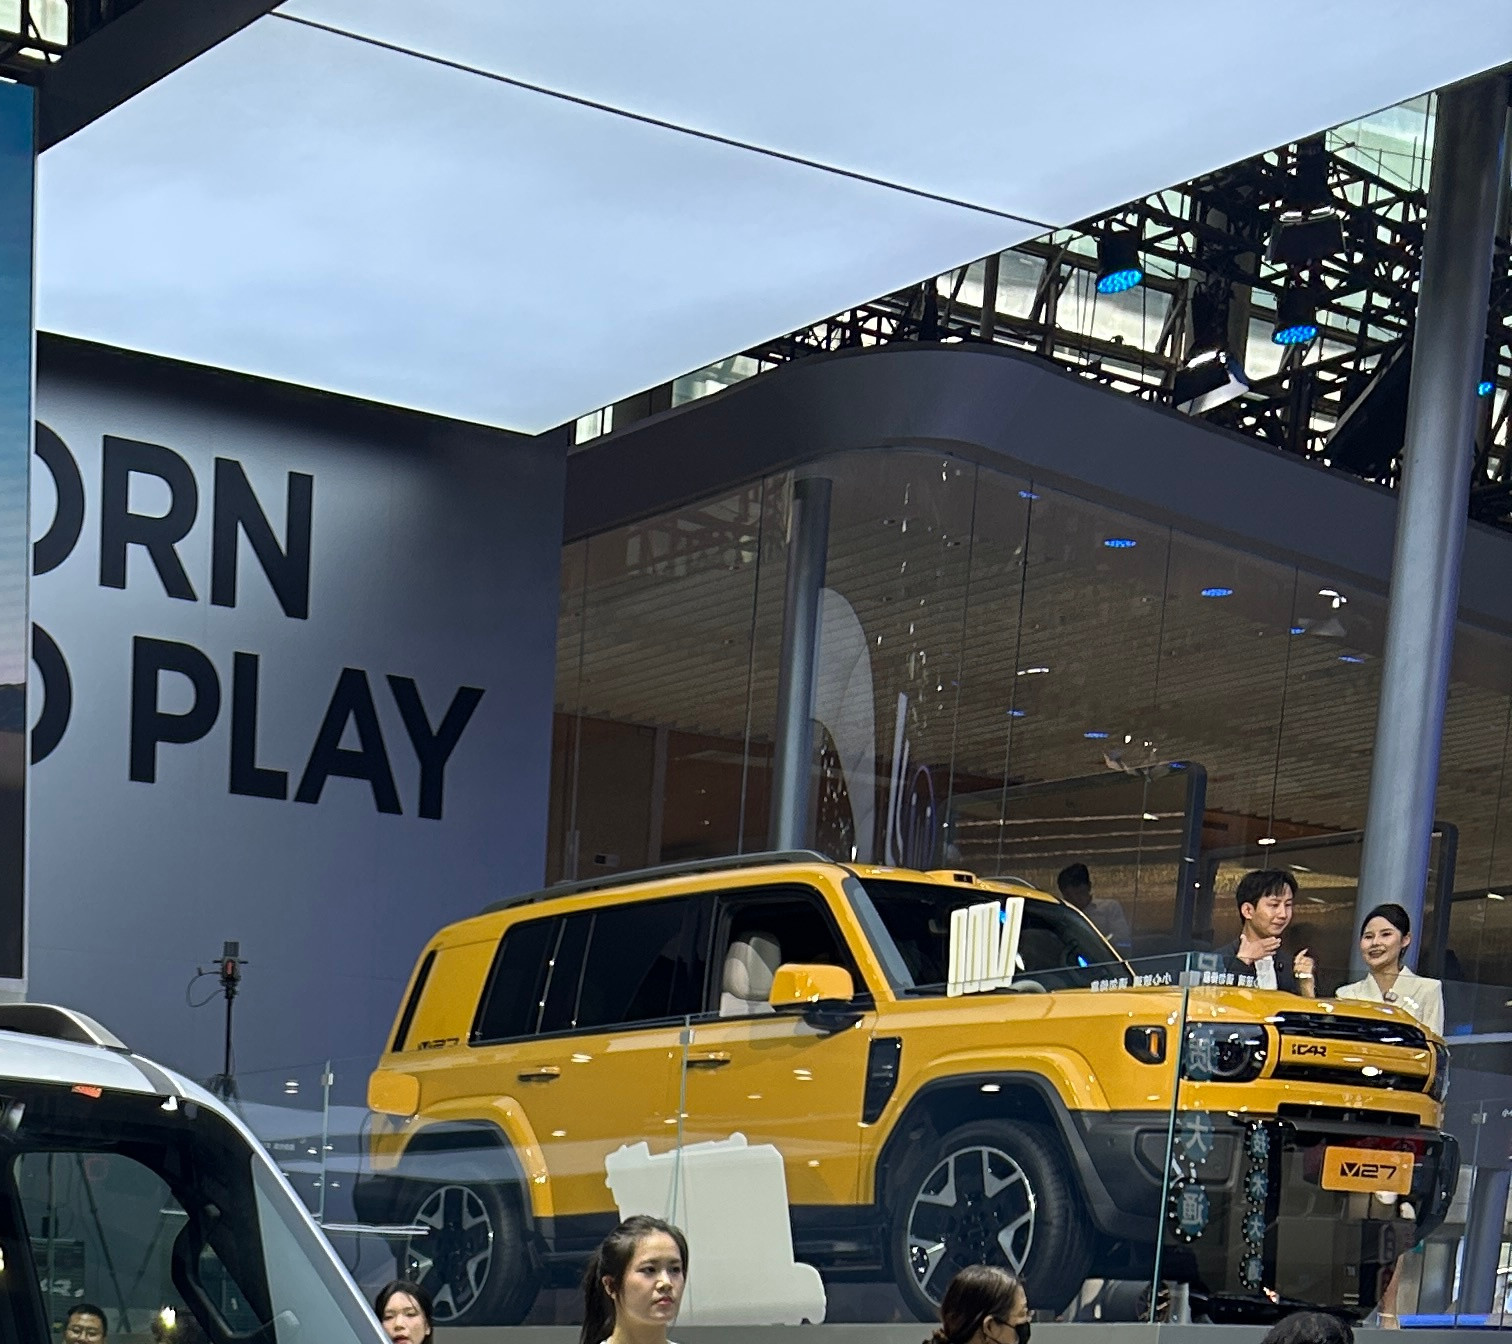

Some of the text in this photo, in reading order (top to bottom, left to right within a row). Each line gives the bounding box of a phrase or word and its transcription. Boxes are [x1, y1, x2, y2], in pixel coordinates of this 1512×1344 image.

[128, 635, 486, 821] PLAY
[1291, 1043, 1327, 1057] iCAR
[1340, 1161, 1397, 1180] V27
